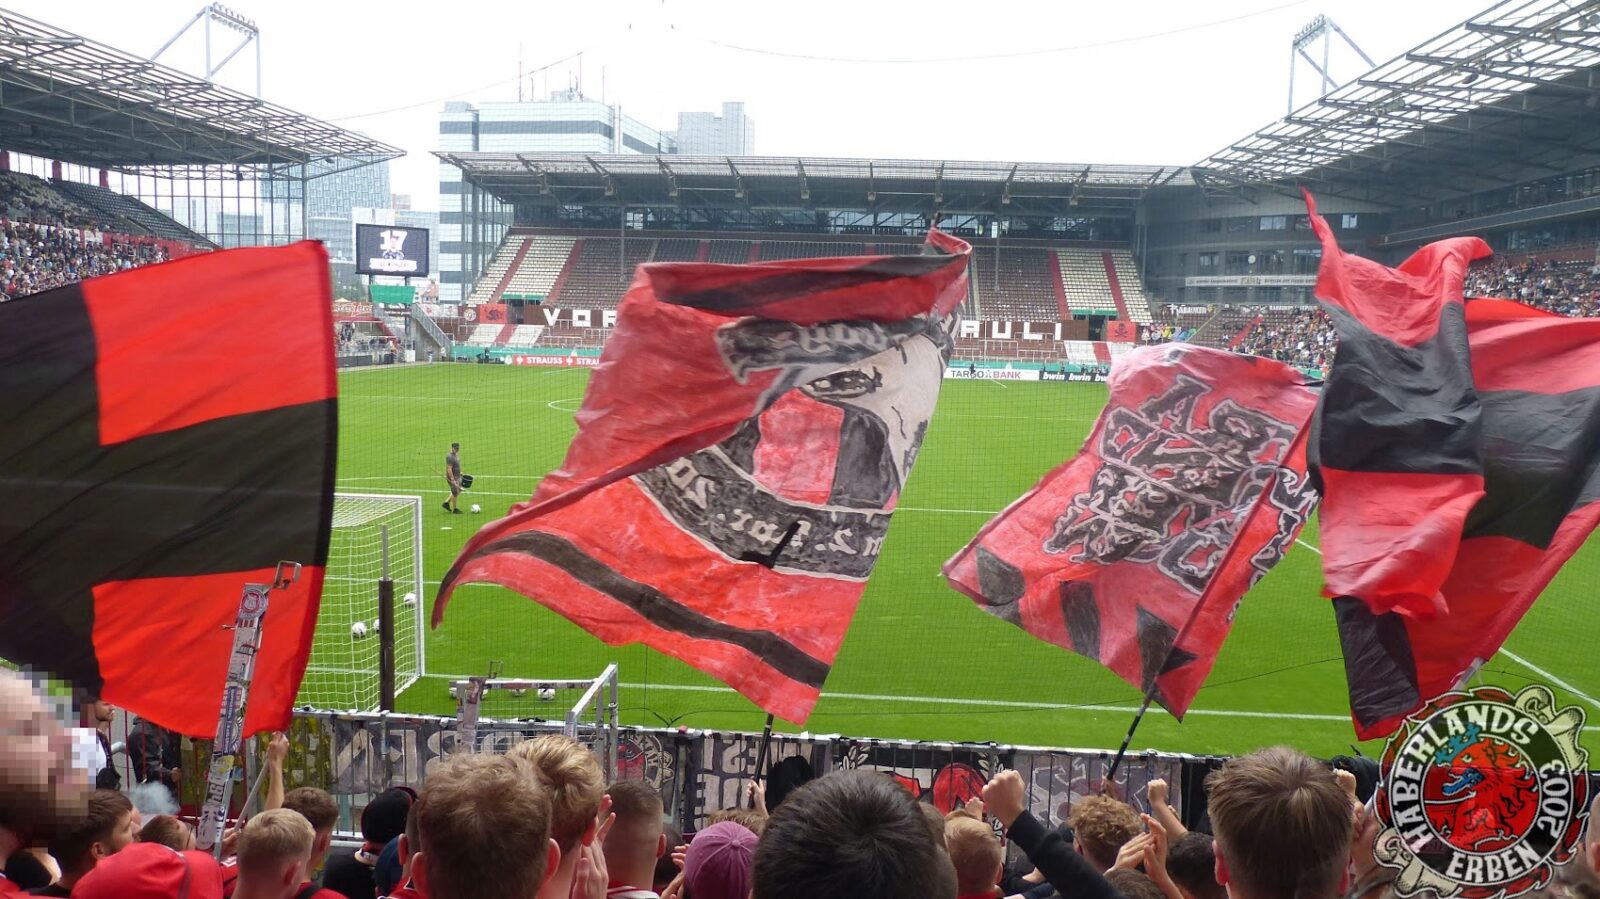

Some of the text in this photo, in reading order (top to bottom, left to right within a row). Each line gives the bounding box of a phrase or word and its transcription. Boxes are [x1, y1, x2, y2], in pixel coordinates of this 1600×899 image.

[380, 230, 407, 250] 17
[526, 356, 562, 364] STRAUSS
[576, 357, 600, 365] STRA
[1042, 371, 1065, 380] bwin
[1068, 372, 1091, 381] bwin
[1095, 373, 1108, 382] bw
